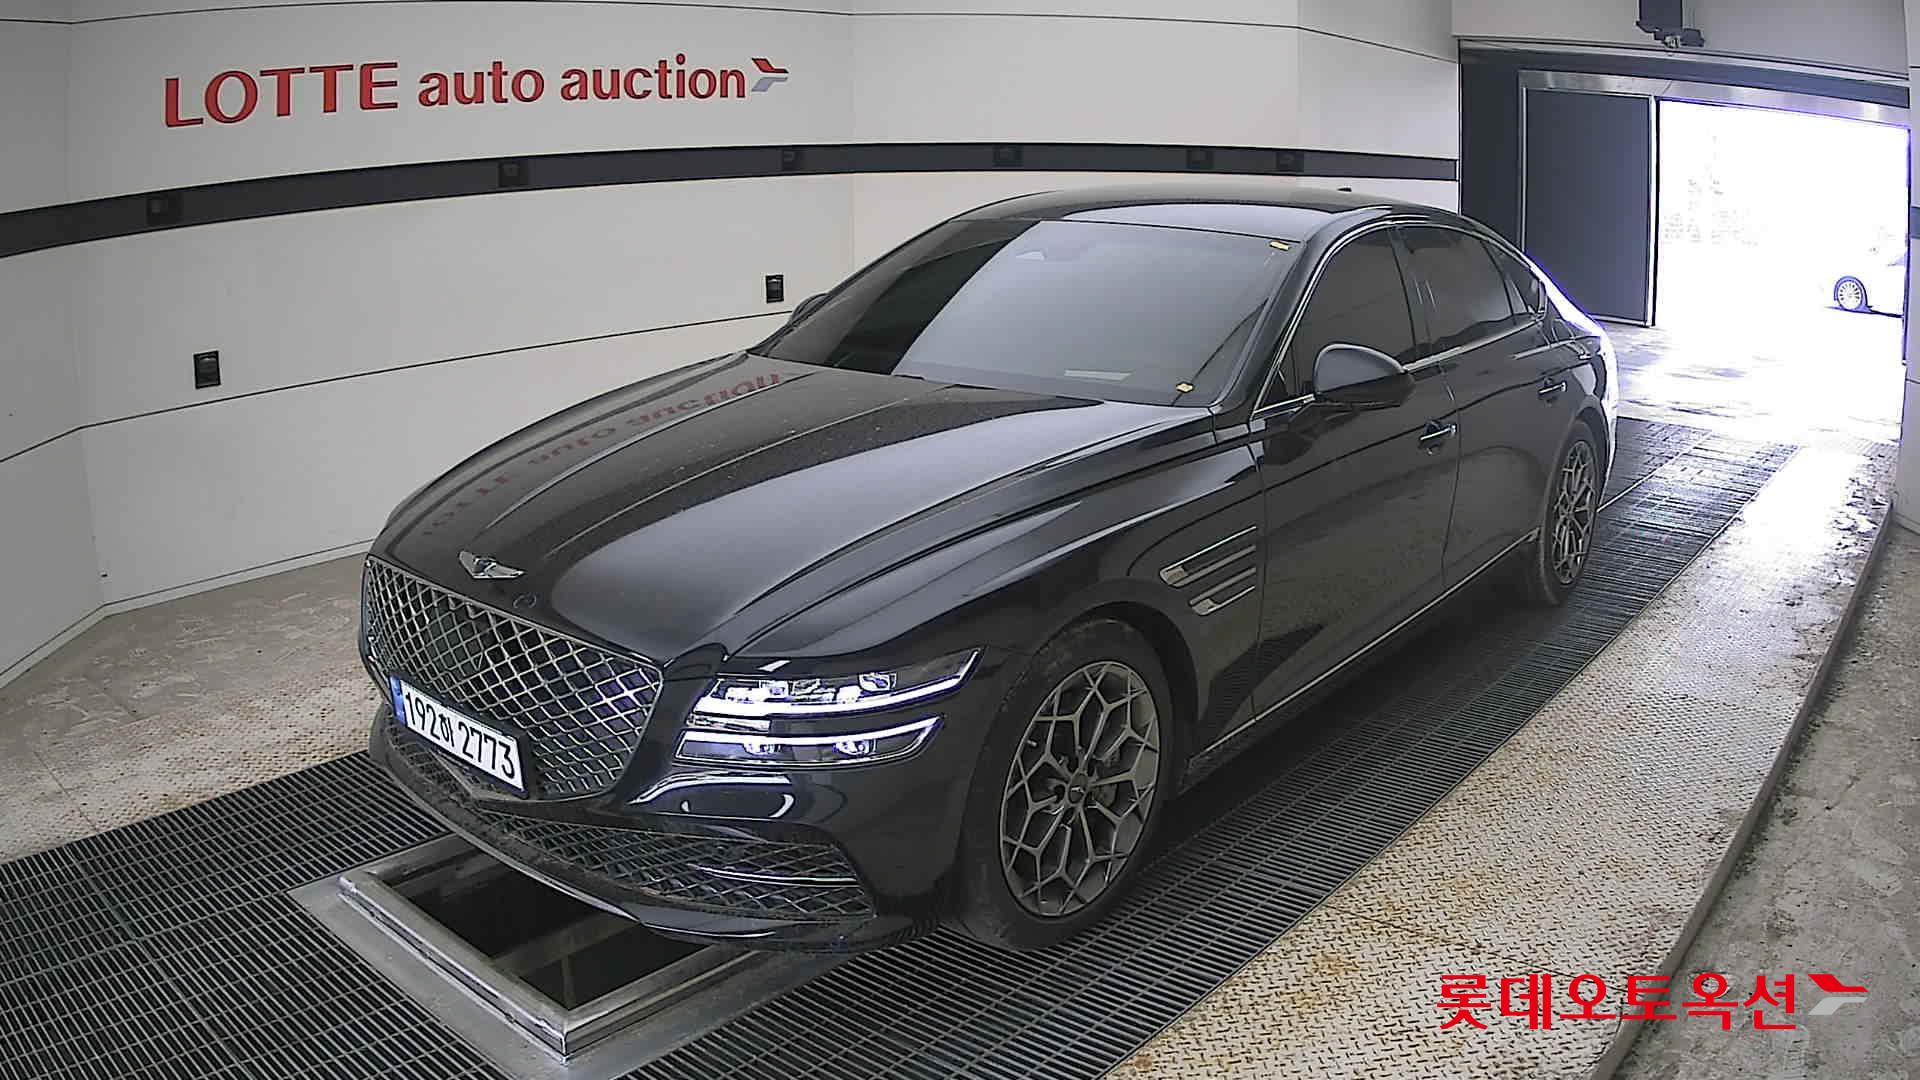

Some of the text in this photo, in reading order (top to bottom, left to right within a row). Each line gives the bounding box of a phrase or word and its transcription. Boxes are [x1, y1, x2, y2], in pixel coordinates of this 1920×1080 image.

[164, 53, 746, 127] LOTTE auto auction
[458, 721, 516, 779] 2773
